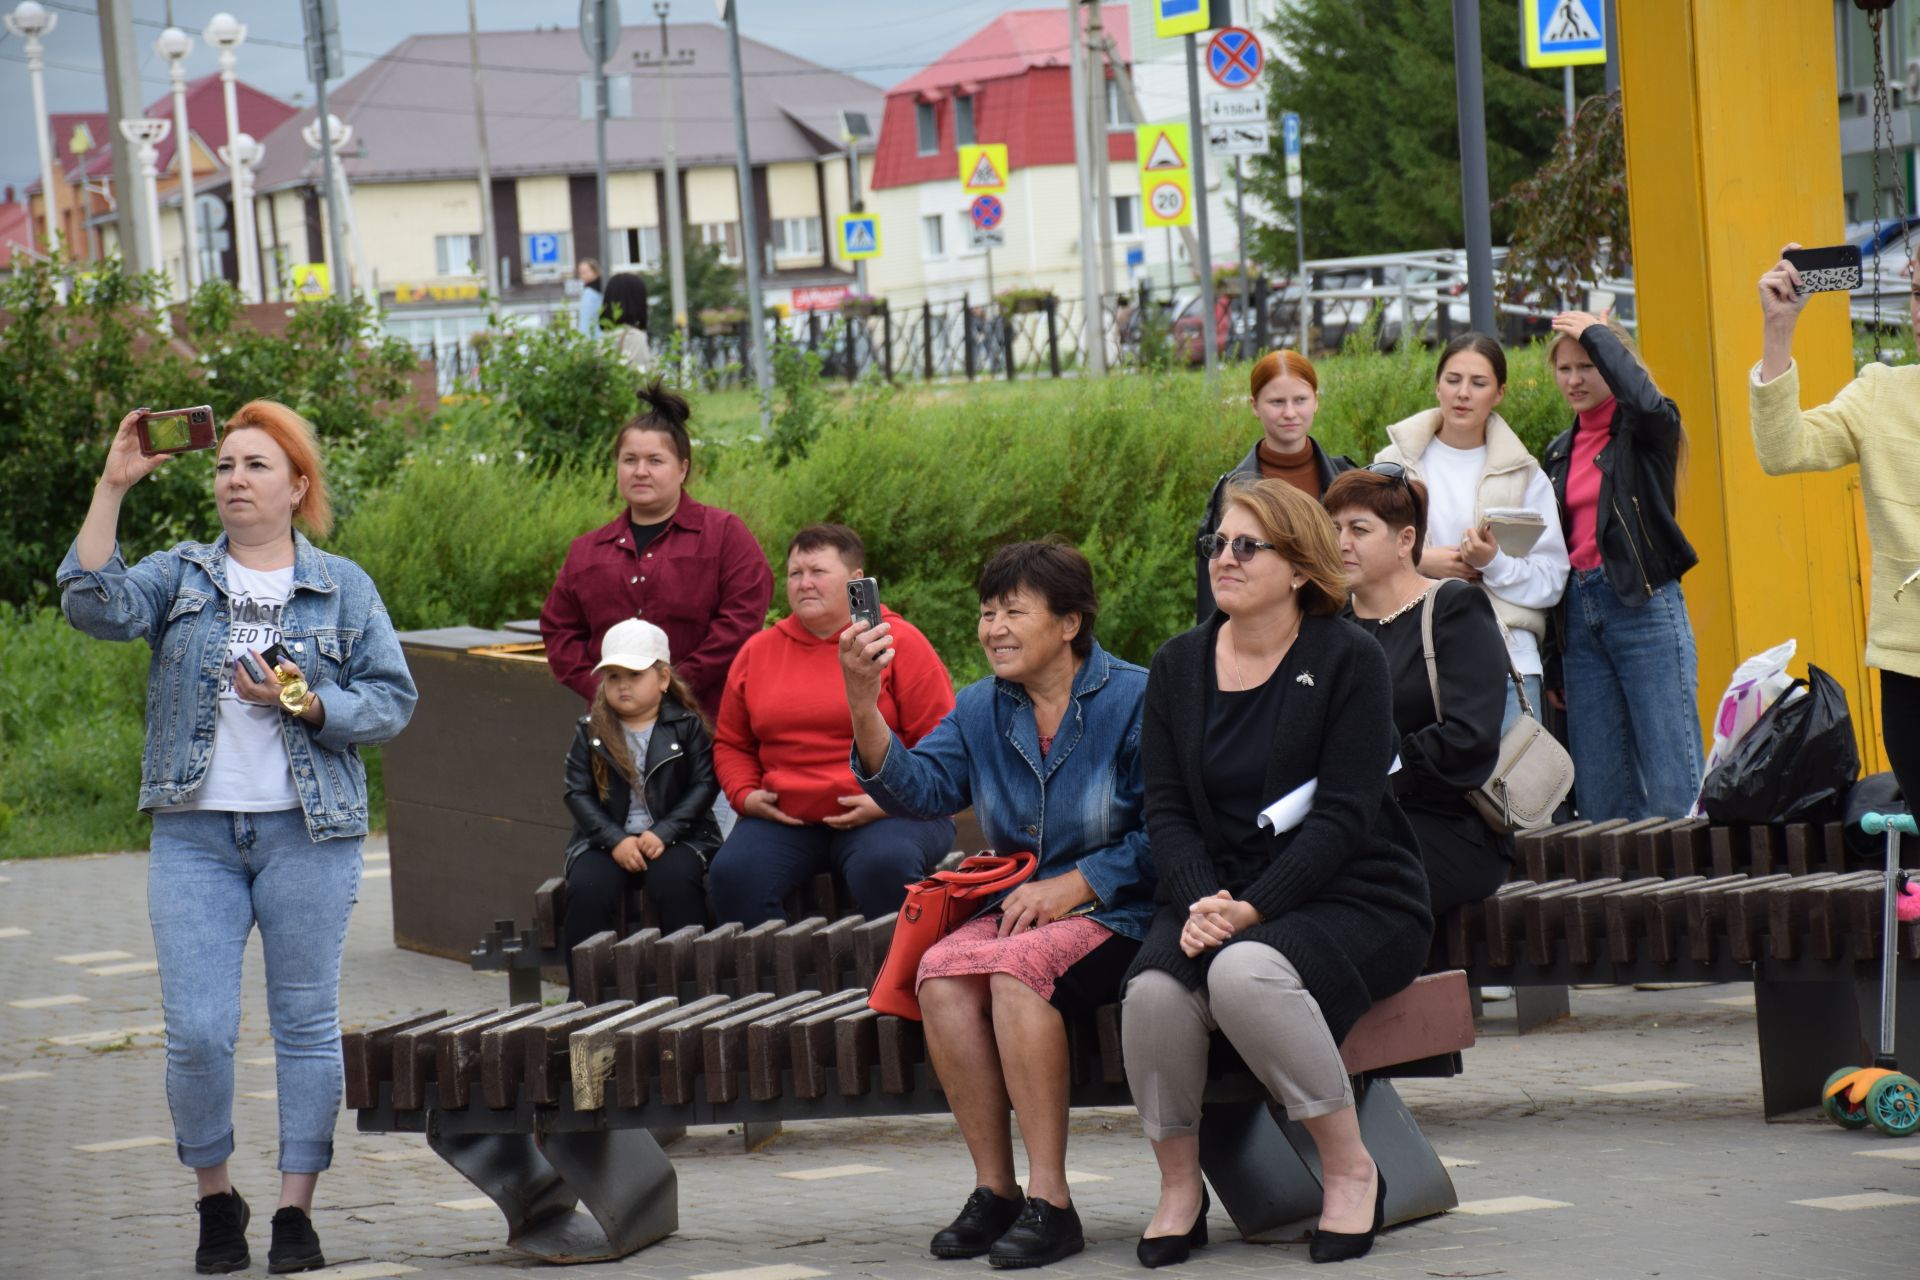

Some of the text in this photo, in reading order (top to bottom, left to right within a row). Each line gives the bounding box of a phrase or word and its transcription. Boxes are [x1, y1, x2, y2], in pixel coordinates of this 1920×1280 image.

[1158, 192, 1179, 209] 20
[537, 235, 554, 262] P
[230, 628, 282, 645] EED TO
